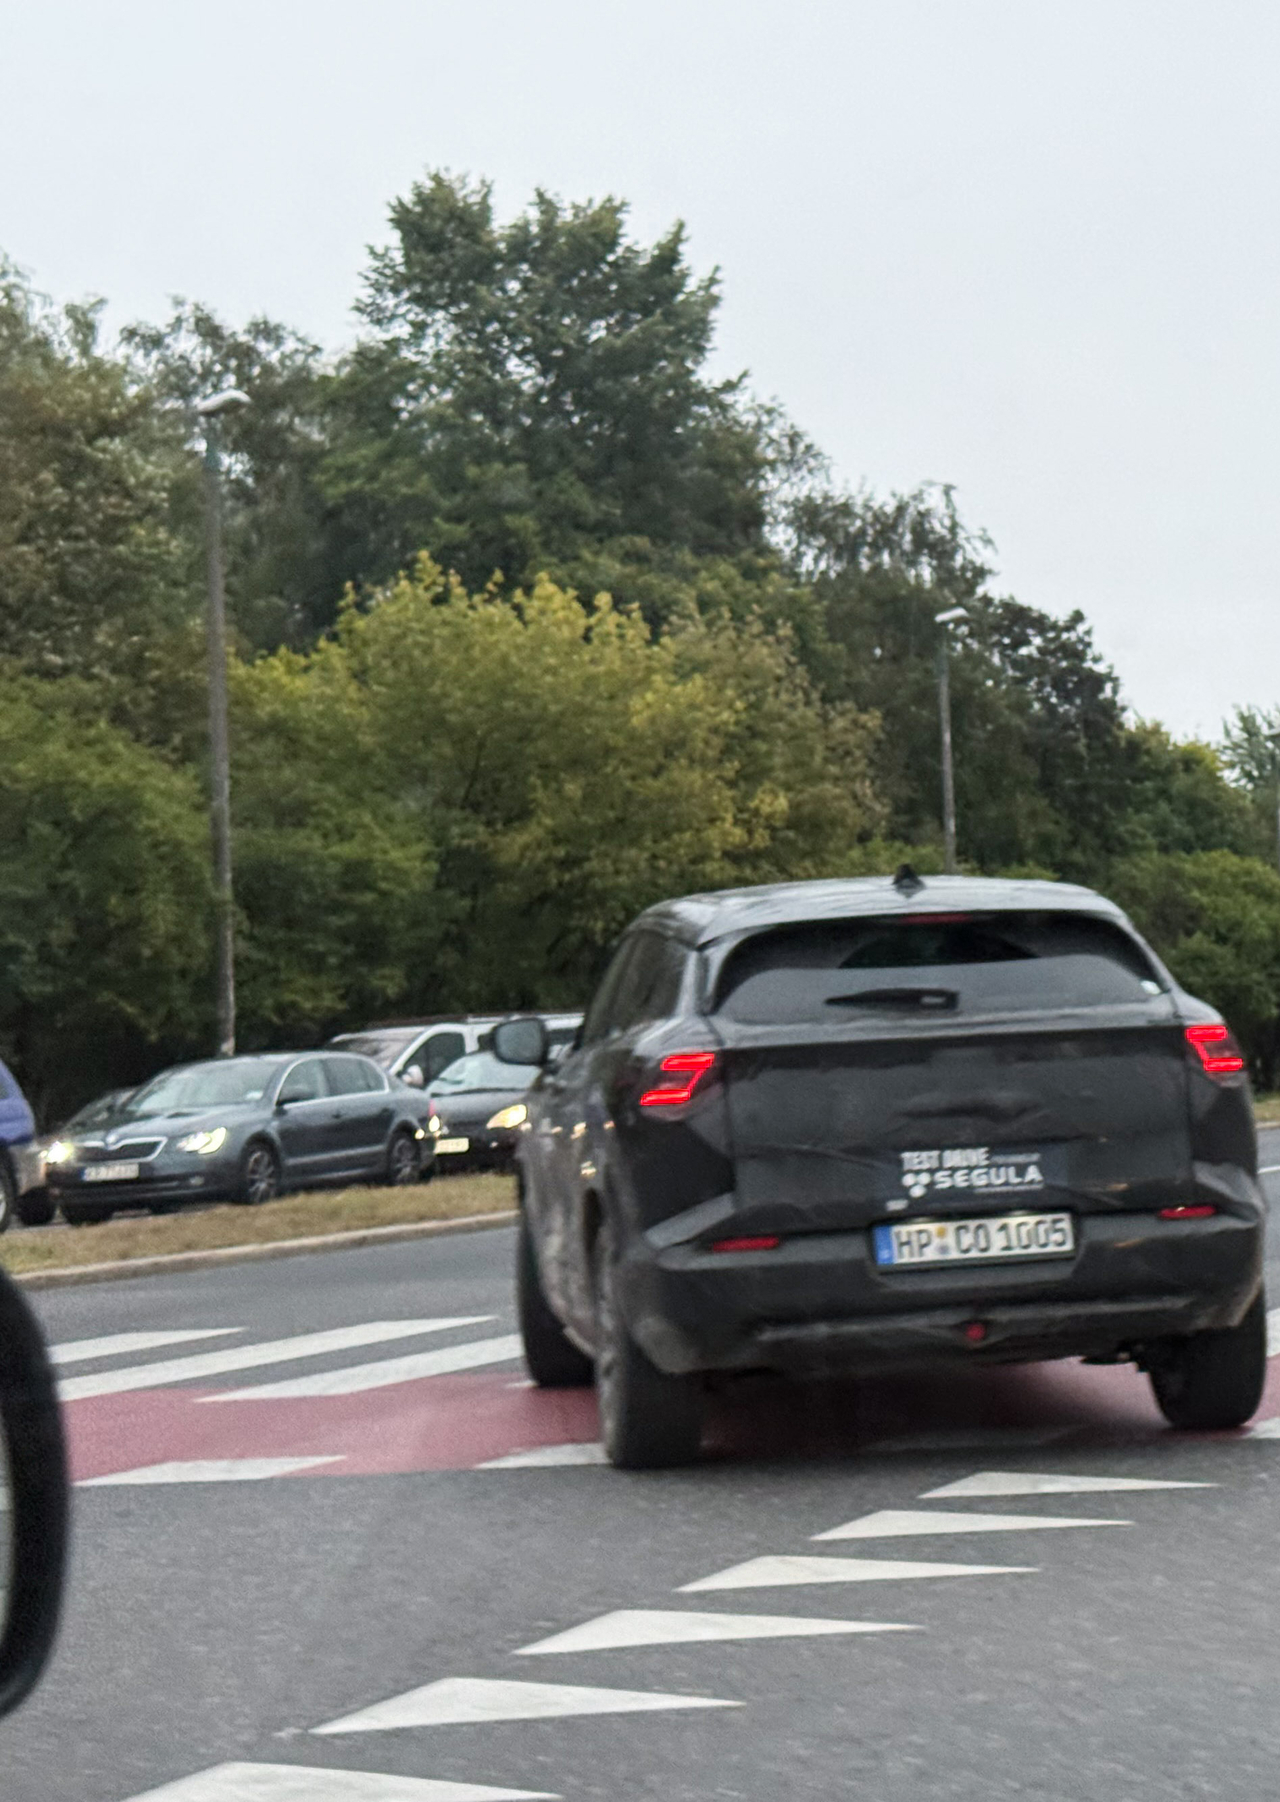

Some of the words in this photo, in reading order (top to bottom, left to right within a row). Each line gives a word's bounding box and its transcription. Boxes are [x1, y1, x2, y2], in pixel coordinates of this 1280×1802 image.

[901, 1150, 941, 1171] TEST
[933, 1165, 1044, 1189] SEGULA
[895, 1228, 933, 1259] HP
[997, 1218, 1067, 1251] 1005
